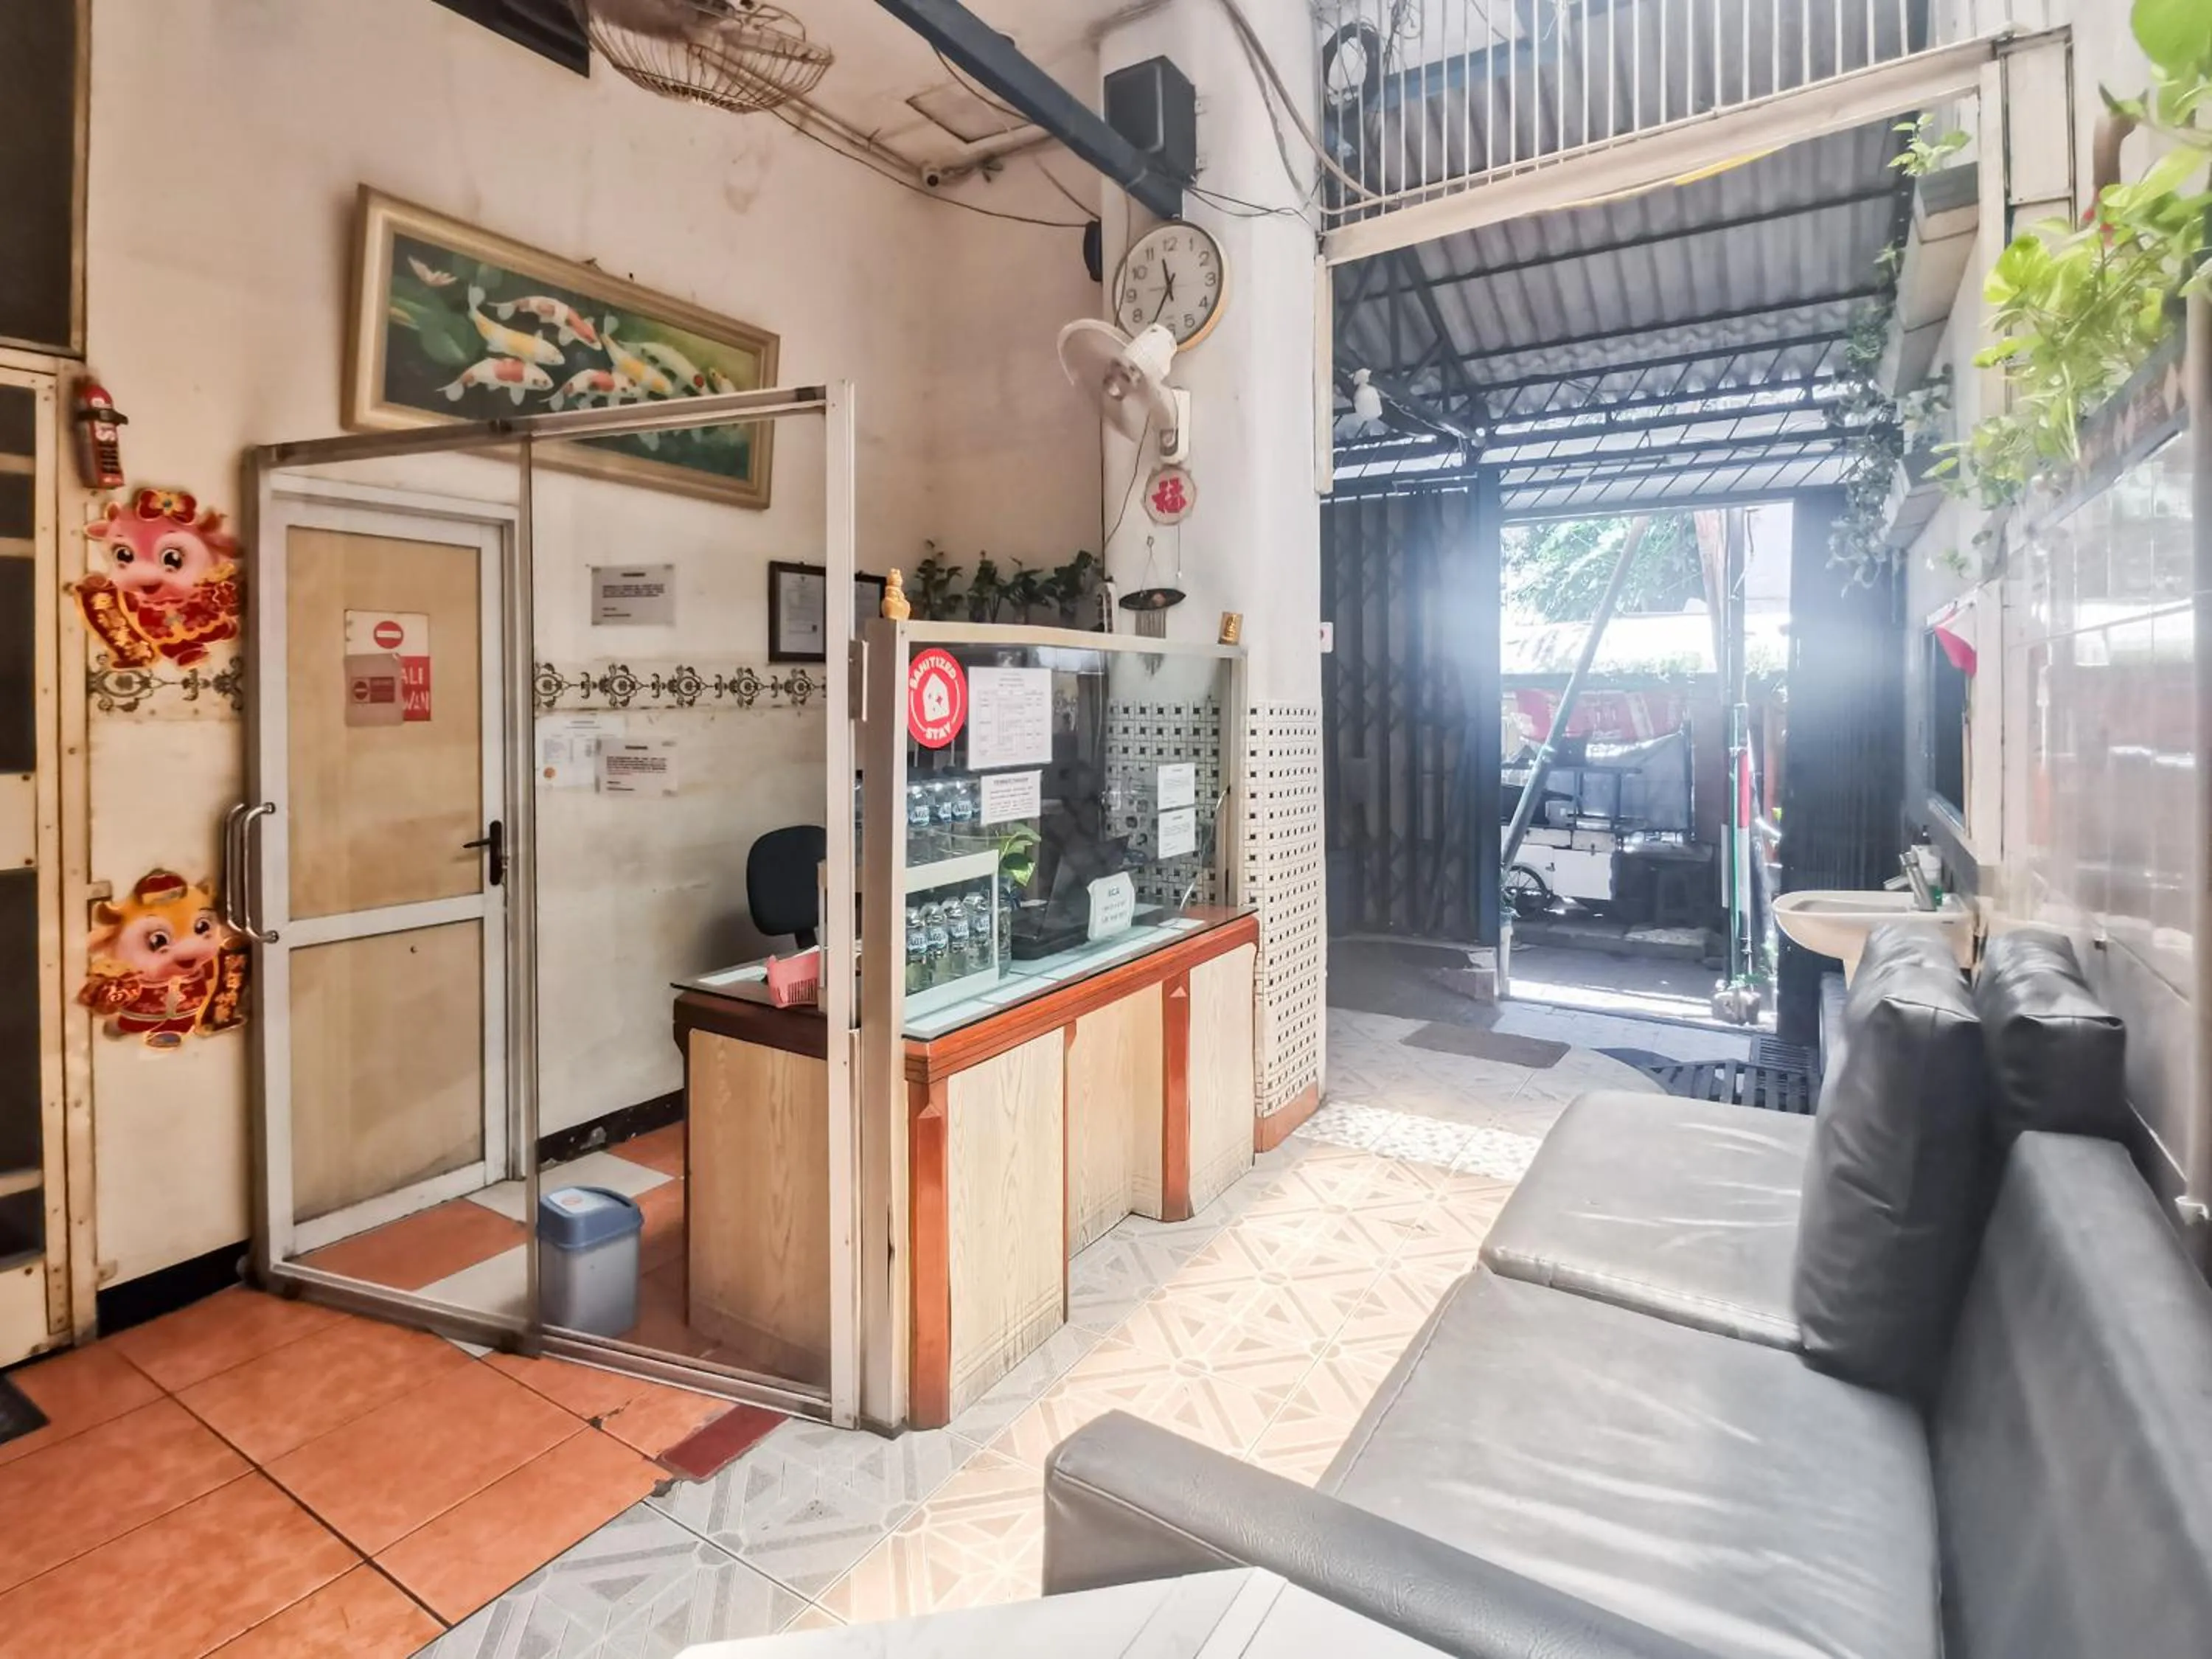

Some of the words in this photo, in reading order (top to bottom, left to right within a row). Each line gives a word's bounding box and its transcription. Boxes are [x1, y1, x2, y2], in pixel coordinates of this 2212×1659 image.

[1163, 236, 1178, 251] 12
[1189, 236, 1194, 251] 1
[1146, 247, 1155, 260] 11
[1198, 251, 1210, 267] 2
[1132, 265, 1147, 280] 10
[1205, 271, 1216, 287] 3
[1125, 288, 1137, 303] 9
[1198, 295, 1208, 310] 4
[1132, 308, 1143, 323] 8
[1183, 313, 1195, 328] 5
[910, 655, 956, 689] SANITIZED
[925, 721, 951, 740] STAY
